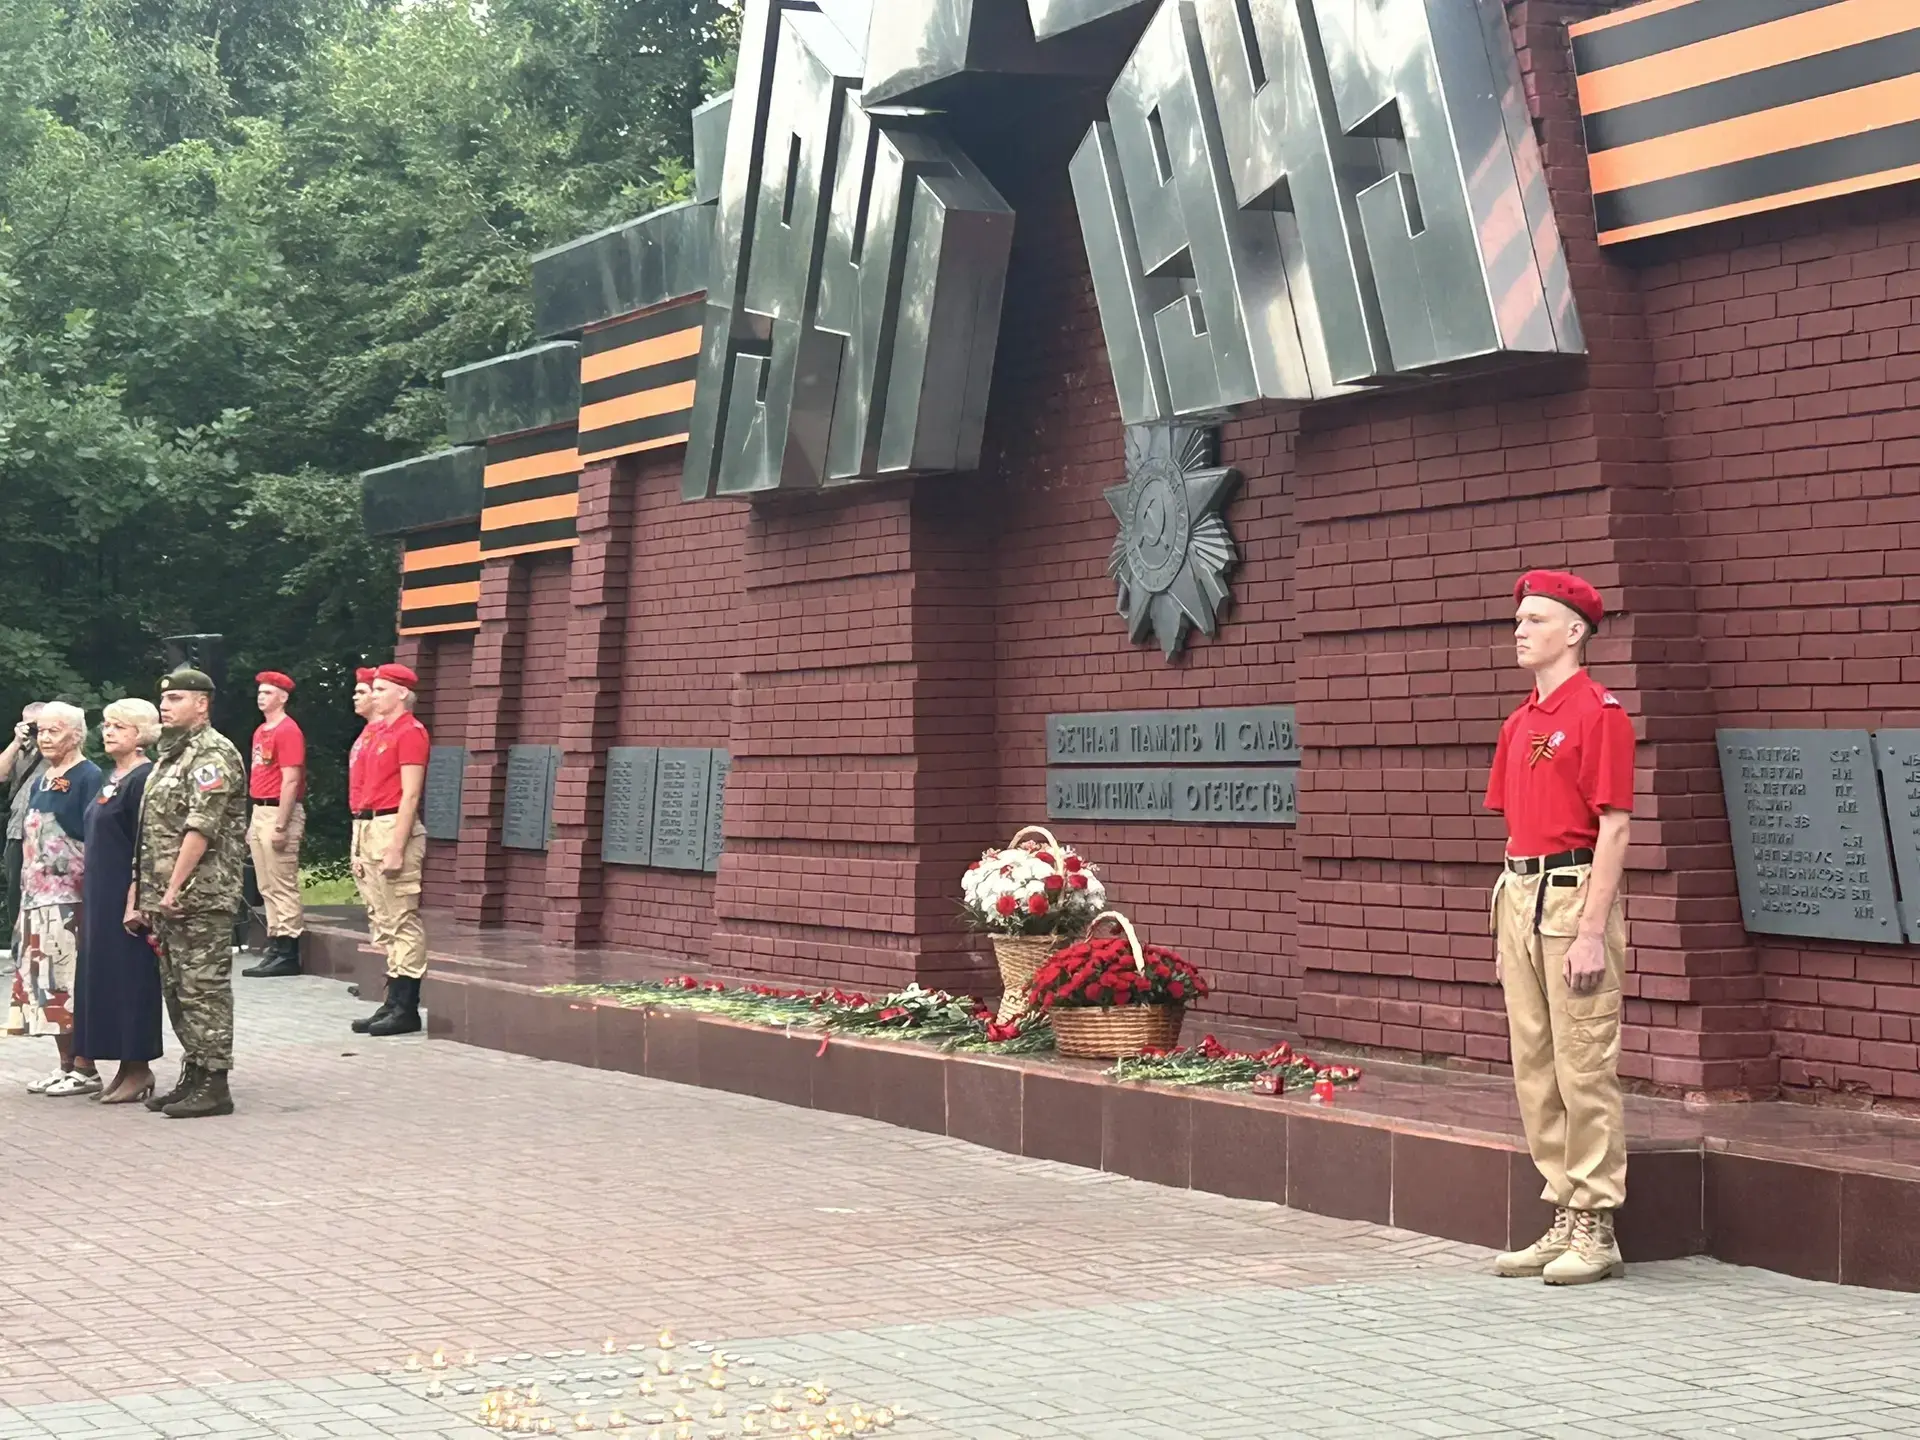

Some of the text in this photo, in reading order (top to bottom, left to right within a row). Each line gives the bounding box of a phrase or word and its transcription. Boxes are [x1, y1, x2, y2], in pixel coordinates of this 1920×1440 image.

[1055, 720, 1298, 754] ВЕЧНАЯ ПАМЯТЬ И СЛАВ
[1055, 780, 1297, 813] ЗАЩИТНИКАМ ОТЕЧЕСТВА
